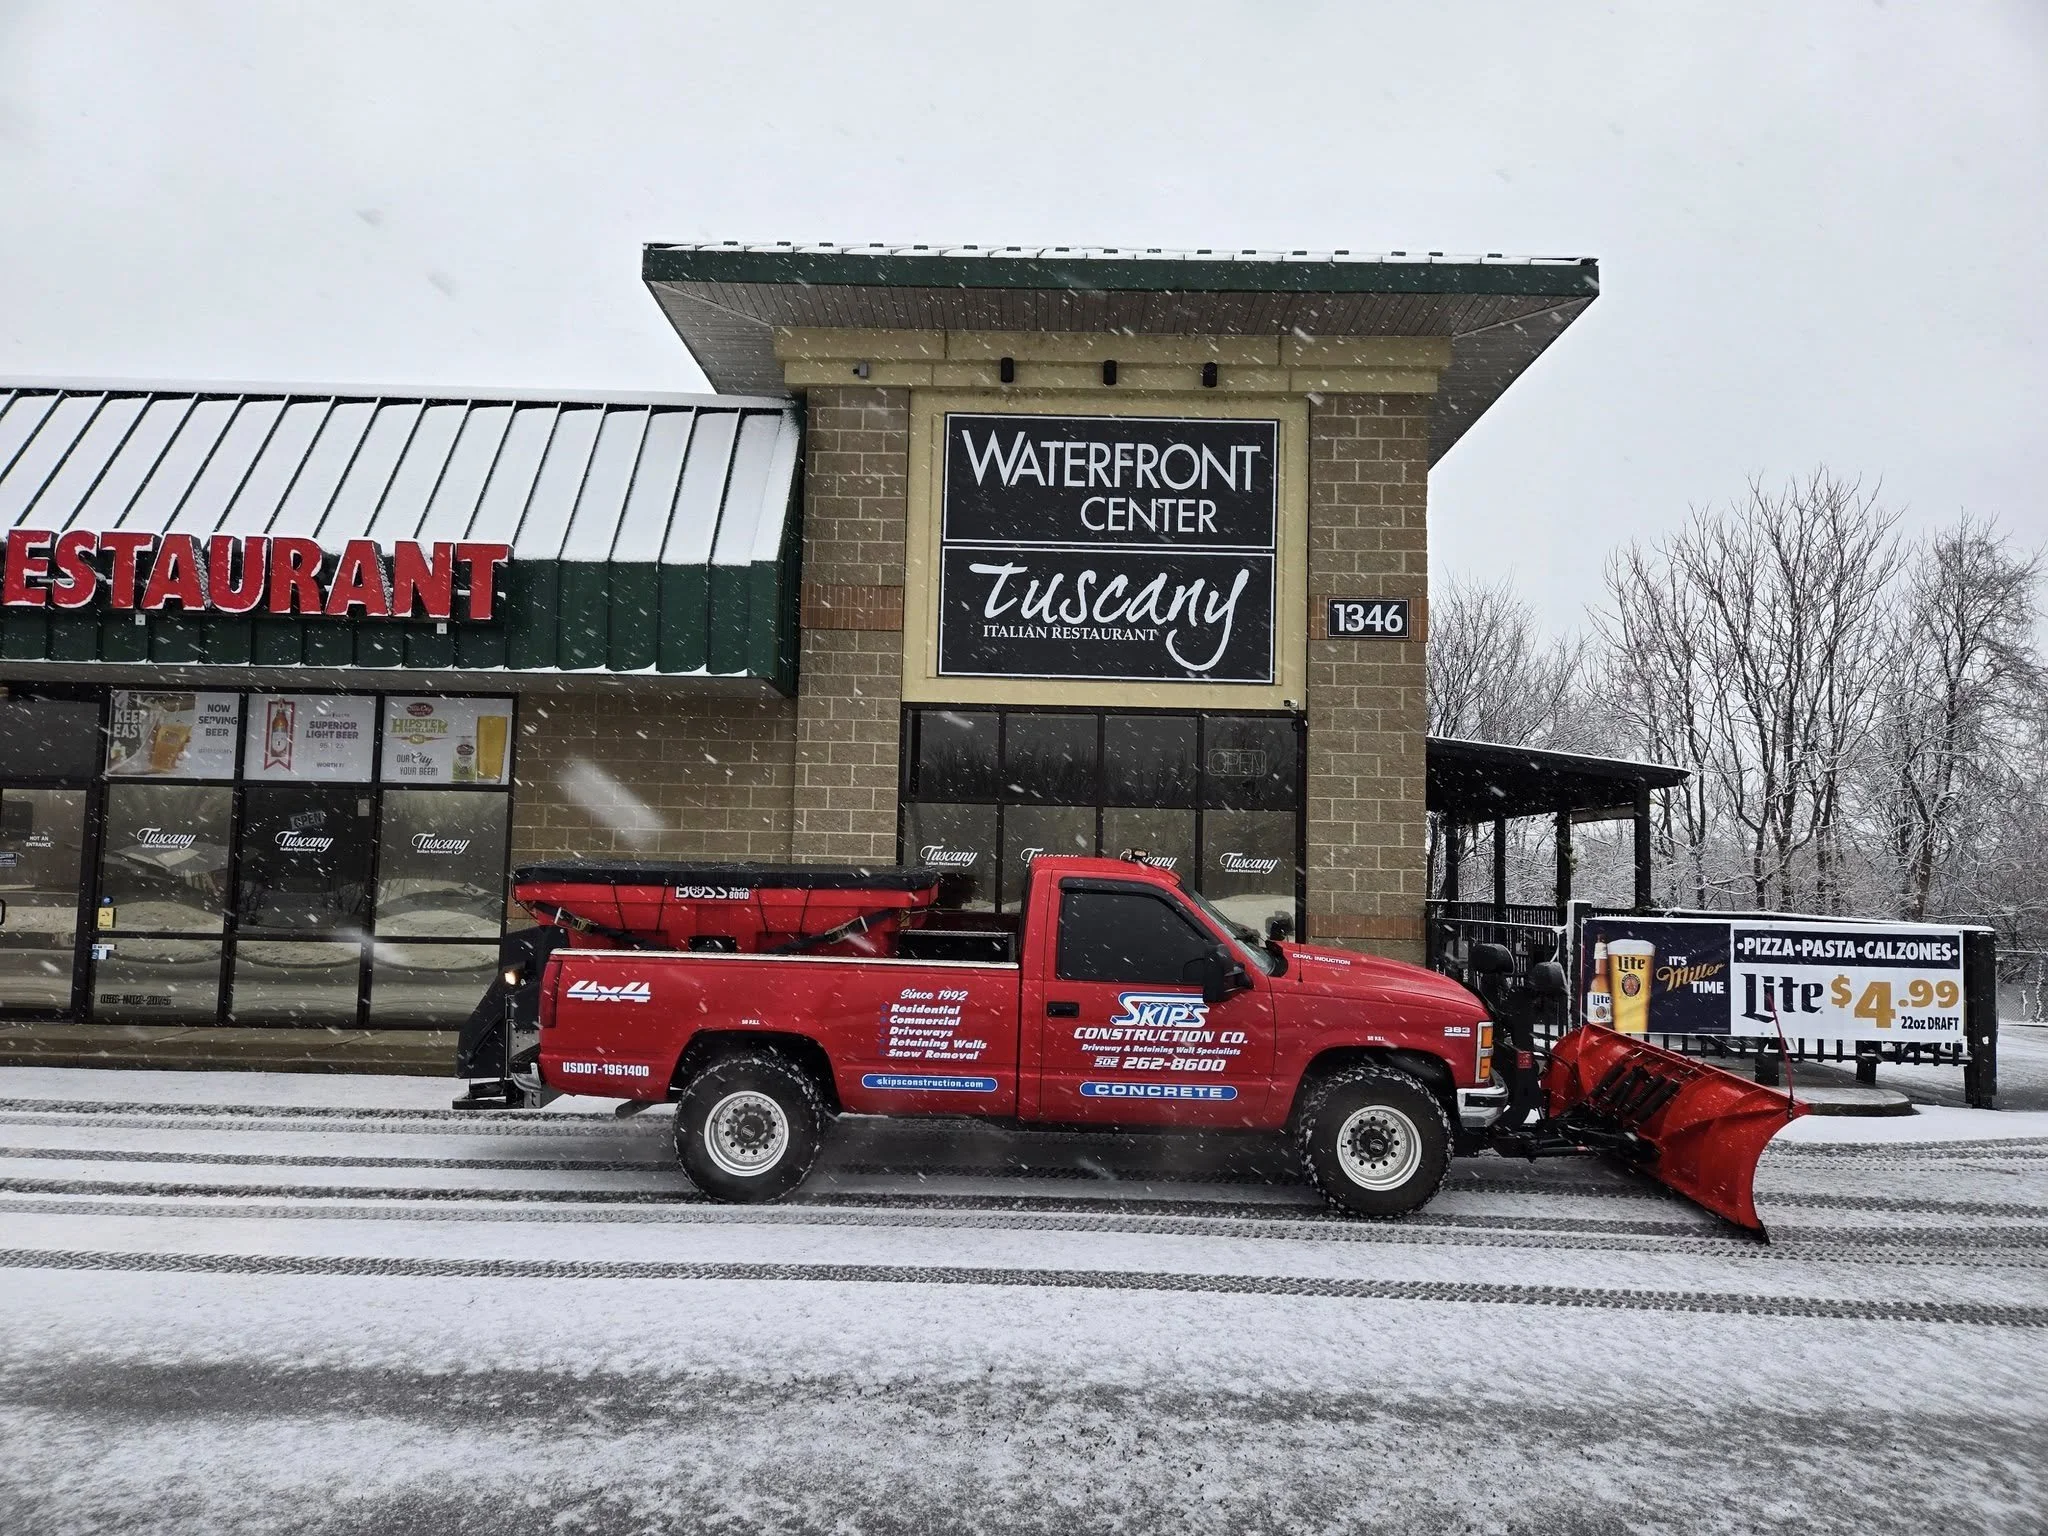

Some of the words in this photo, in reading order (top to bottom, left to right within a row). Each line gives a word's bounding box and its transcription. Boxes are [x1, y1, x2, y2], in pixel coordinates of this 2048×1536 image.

[961, 429, 1261, 491] WATERFRONT
[1080, 496, 1218, 533] CENTER
[3, 529, 511, 620] ESTAURANT
[968, 562, 1250, 671] Tuscany
[1333, 603, 1403, 633] 1346
[983, 624, 1048, 640] ITALIAN
[1051, 625, 1157, 642] RESTAURANT
[207, 704, 231, 713] NOW
[198, 716, 238, 725] SERVING
[309, 720, 357, 730] SUPERIOR
[391, 718, 449, 733] HIPSTER
[205, 728, 230, 737] BEER
[305, 730, 335, 739] LIGHT
[335, 730, 359, 740] BEER
[396, 754, 410, 763] OUR
[399, 766, 417, 776] YOUR
[419, 766, 438, 776] BEER!
[293, 813, 323, 828] OPEN
[136, 827, 196, 849] Tuscany
[274, 830, 334, 852] Tuscany
[411, 833, 470, 855] Tuscany
[920, 845, 978, 867] Tuscany
[1219, 852, 1278, 874] Tuscany
[729, 891, 750, 900] 8000
[1744, 937, 1795, 957] PIZZA
[1801, 938, 1856, 959] PASTA
[1863, 941, 1952, 961] CALZONES
[1617, 956, 1646, 973] Lite
[1668, 955, 1687, 966] IT'S
[1656, 963, 1726, 992] Miller
[566, 980, 651, 1003] 4x4
[900, 988, 934, 1000] Since
[937, 989, 968, 1001] 1992
[1690, 981, 1725, 994] TIME
[1592, 994, 1610, 1006] Lite
[1741, 973, 1824, 1023] Lite
[1830, 974, 1960, 1029] $4.99
[890, 1003, 961, 1015] Residential
[889, 1015, 961, 1026] Commercial
[1901, 1015, 1926, 1031] 22oz
[1927, 1016, 1960, 1031] DRAFT
[889, 1026, 954, 1039] Driveways
[1073, 1027, 1216, 1043] CONSTRUCTION
[1219, 1031, 1249, 1044] CO.
[889, 1037, 949, 1050] Retaining
[953, 1039, 988, 1049] Walls
[1081, 1043, 1123, 1054] Driveway
[1124, 1044, 1131, 1052] &
[1133, 1045, 1174, 1055] Retaining
[1176, 1046, 1196, 1054] Wall
[1196, 1046, 1242, 1056] Specialists
[888, 1048, 922, 1058] Snow
[925, 1050, 980, 1060] Removal
[562, 1062, 650, 1077] USDOT-1961400
[1094, 1056, 1120, 1067] 502
[1122, 1056, 1227, 1072] 262-8600
[876, 1077, 984, 1088] skipsconstruction.com
[1094, 1084, 1223, 1098] CONCRETE
